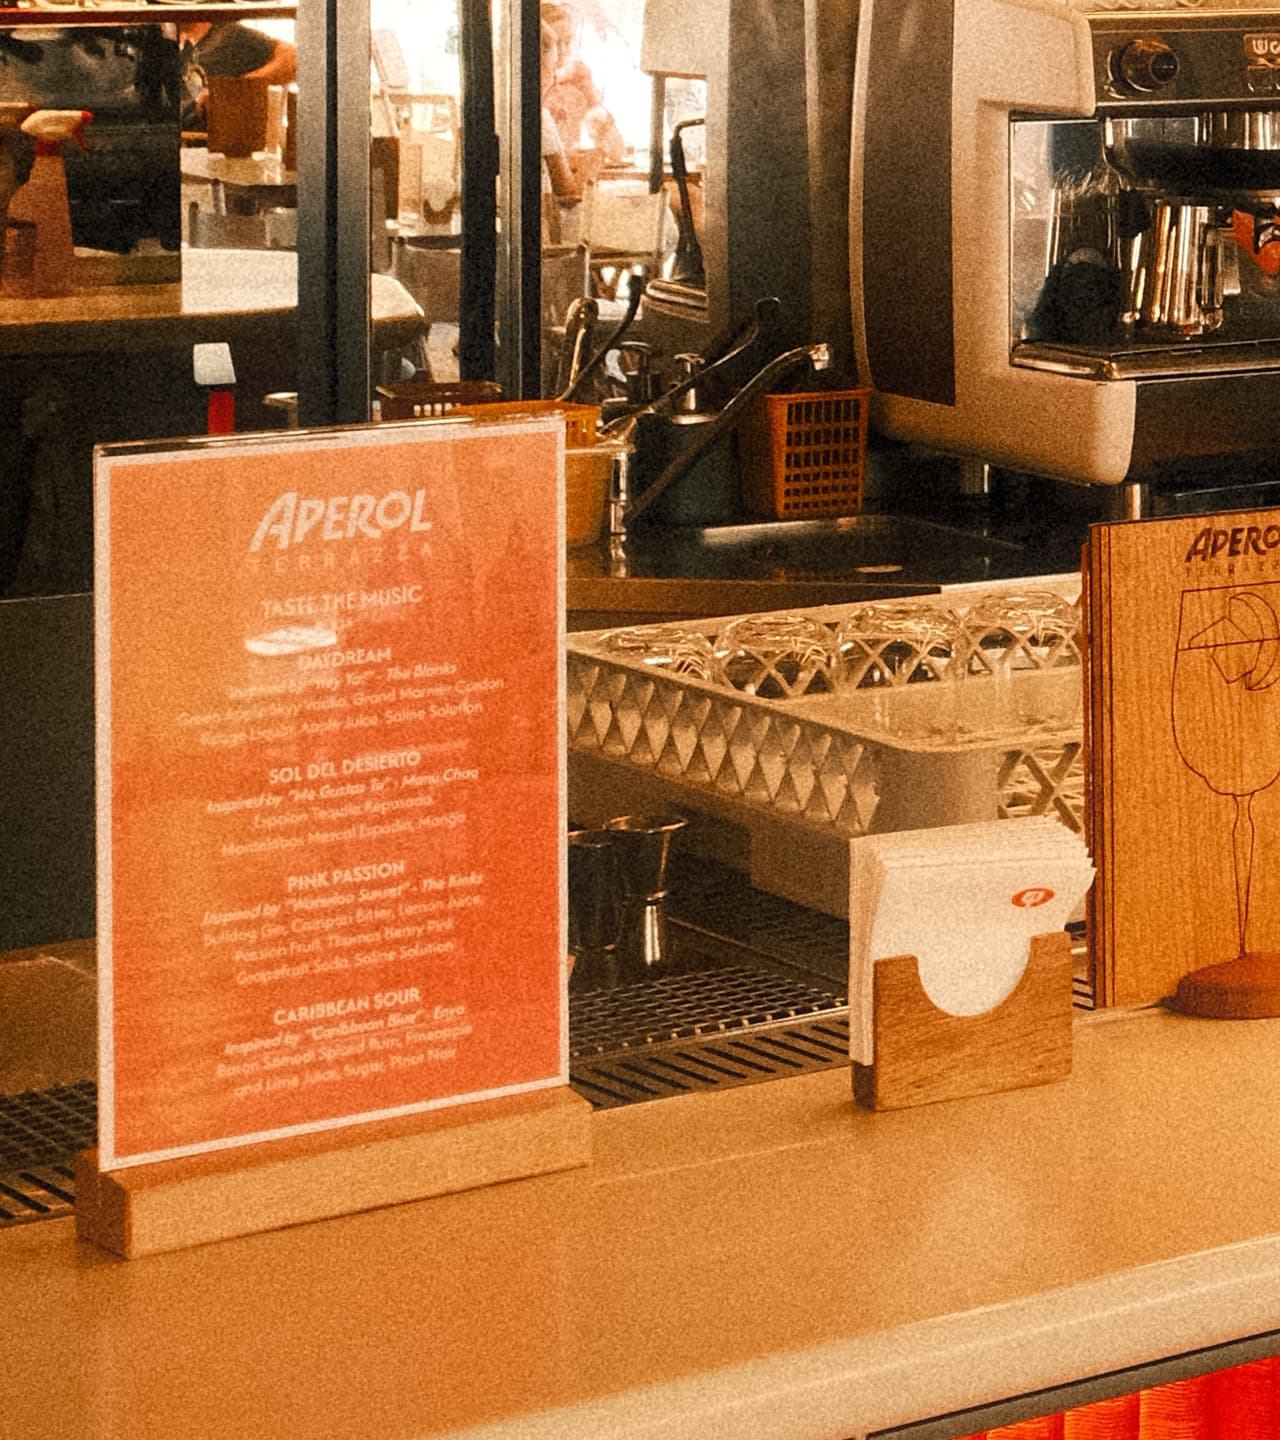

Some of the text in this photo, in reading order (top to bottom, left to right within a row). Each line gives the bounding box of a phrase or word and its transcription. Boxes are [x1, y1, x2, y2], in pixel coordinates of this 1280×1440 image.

[250, 488, 432, 552] APEROL
[249, 541, 433, 574] TERRAZZA
[261, 585, 423, 618] TASTE THE MUSIC
[298, 646, 391, 671] DAYDREAM
[269, 751, 420, 784] SOL DEL DESIERTO
[287, 861, 404, 892] PINK PASSION
[273, 988, 420, 1027] CARIBBEAN SOUR
